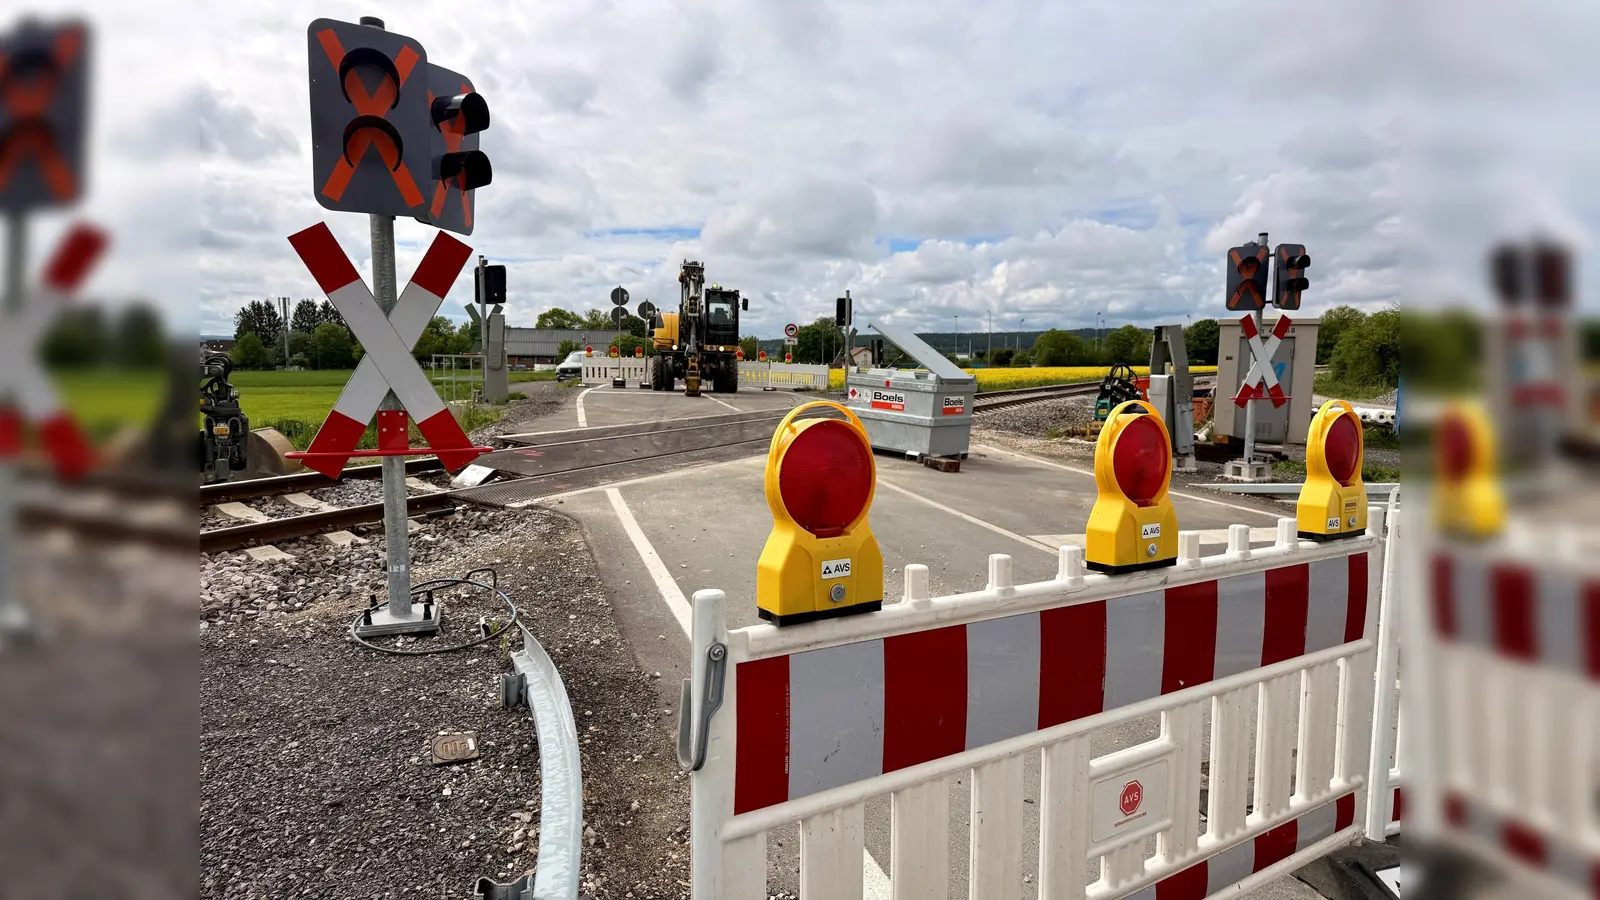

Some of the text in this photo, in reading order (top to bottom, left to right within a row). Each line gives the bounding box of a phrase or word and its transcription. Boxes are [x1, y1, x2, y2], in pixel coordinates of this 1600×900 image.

[874, 391, 904, 403] Boels
[944, 397, 964, 406] Boels
[1328, 519, 1339, 528] AVS
[1149, 526, 1160, 535] AVS
[834, 563, 850, 573] AVS
[1124, 791, 1139, 805] AVS
